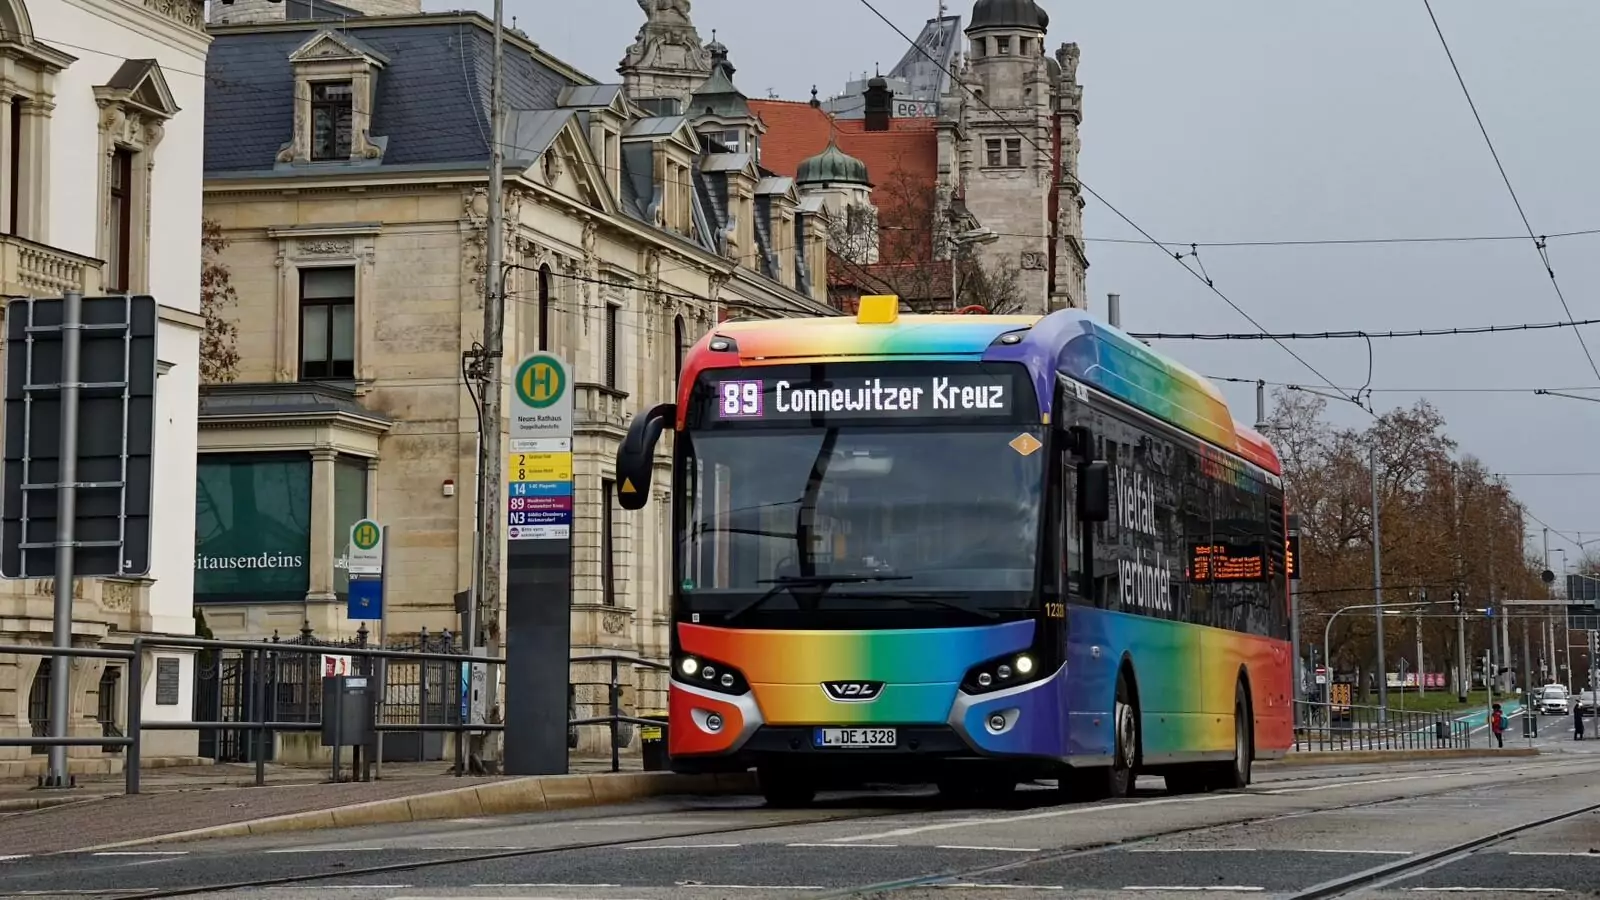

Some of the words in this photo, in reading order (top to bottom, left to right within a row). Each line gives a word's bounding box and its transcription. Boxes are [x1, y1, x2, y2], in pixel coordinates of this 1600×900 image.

[530, 367, 551, 397] H
[723, 382, 759, 416] 89
[776, 379, 924, 412] Connewitzer
[932, 376, 1003, 409] Kreuz
[519, 454, 526, 466] 2
[518, 468, 526, 481] 8
[514, 483, 526, 495] 14
[510, 498, 525, 510] 89
[1115, 464, 1157, 537] Vielfalt
[510, 511, 526, 525] N3
[362, 527, 372, 544] H
[1117, 546, 1172, 612] verbindet
[832, 683, 874, 695] VDL
[823, 730, 832, 744] L
[840, 730, 858, 744] DE
[861, 730, 895, 744] 1328
